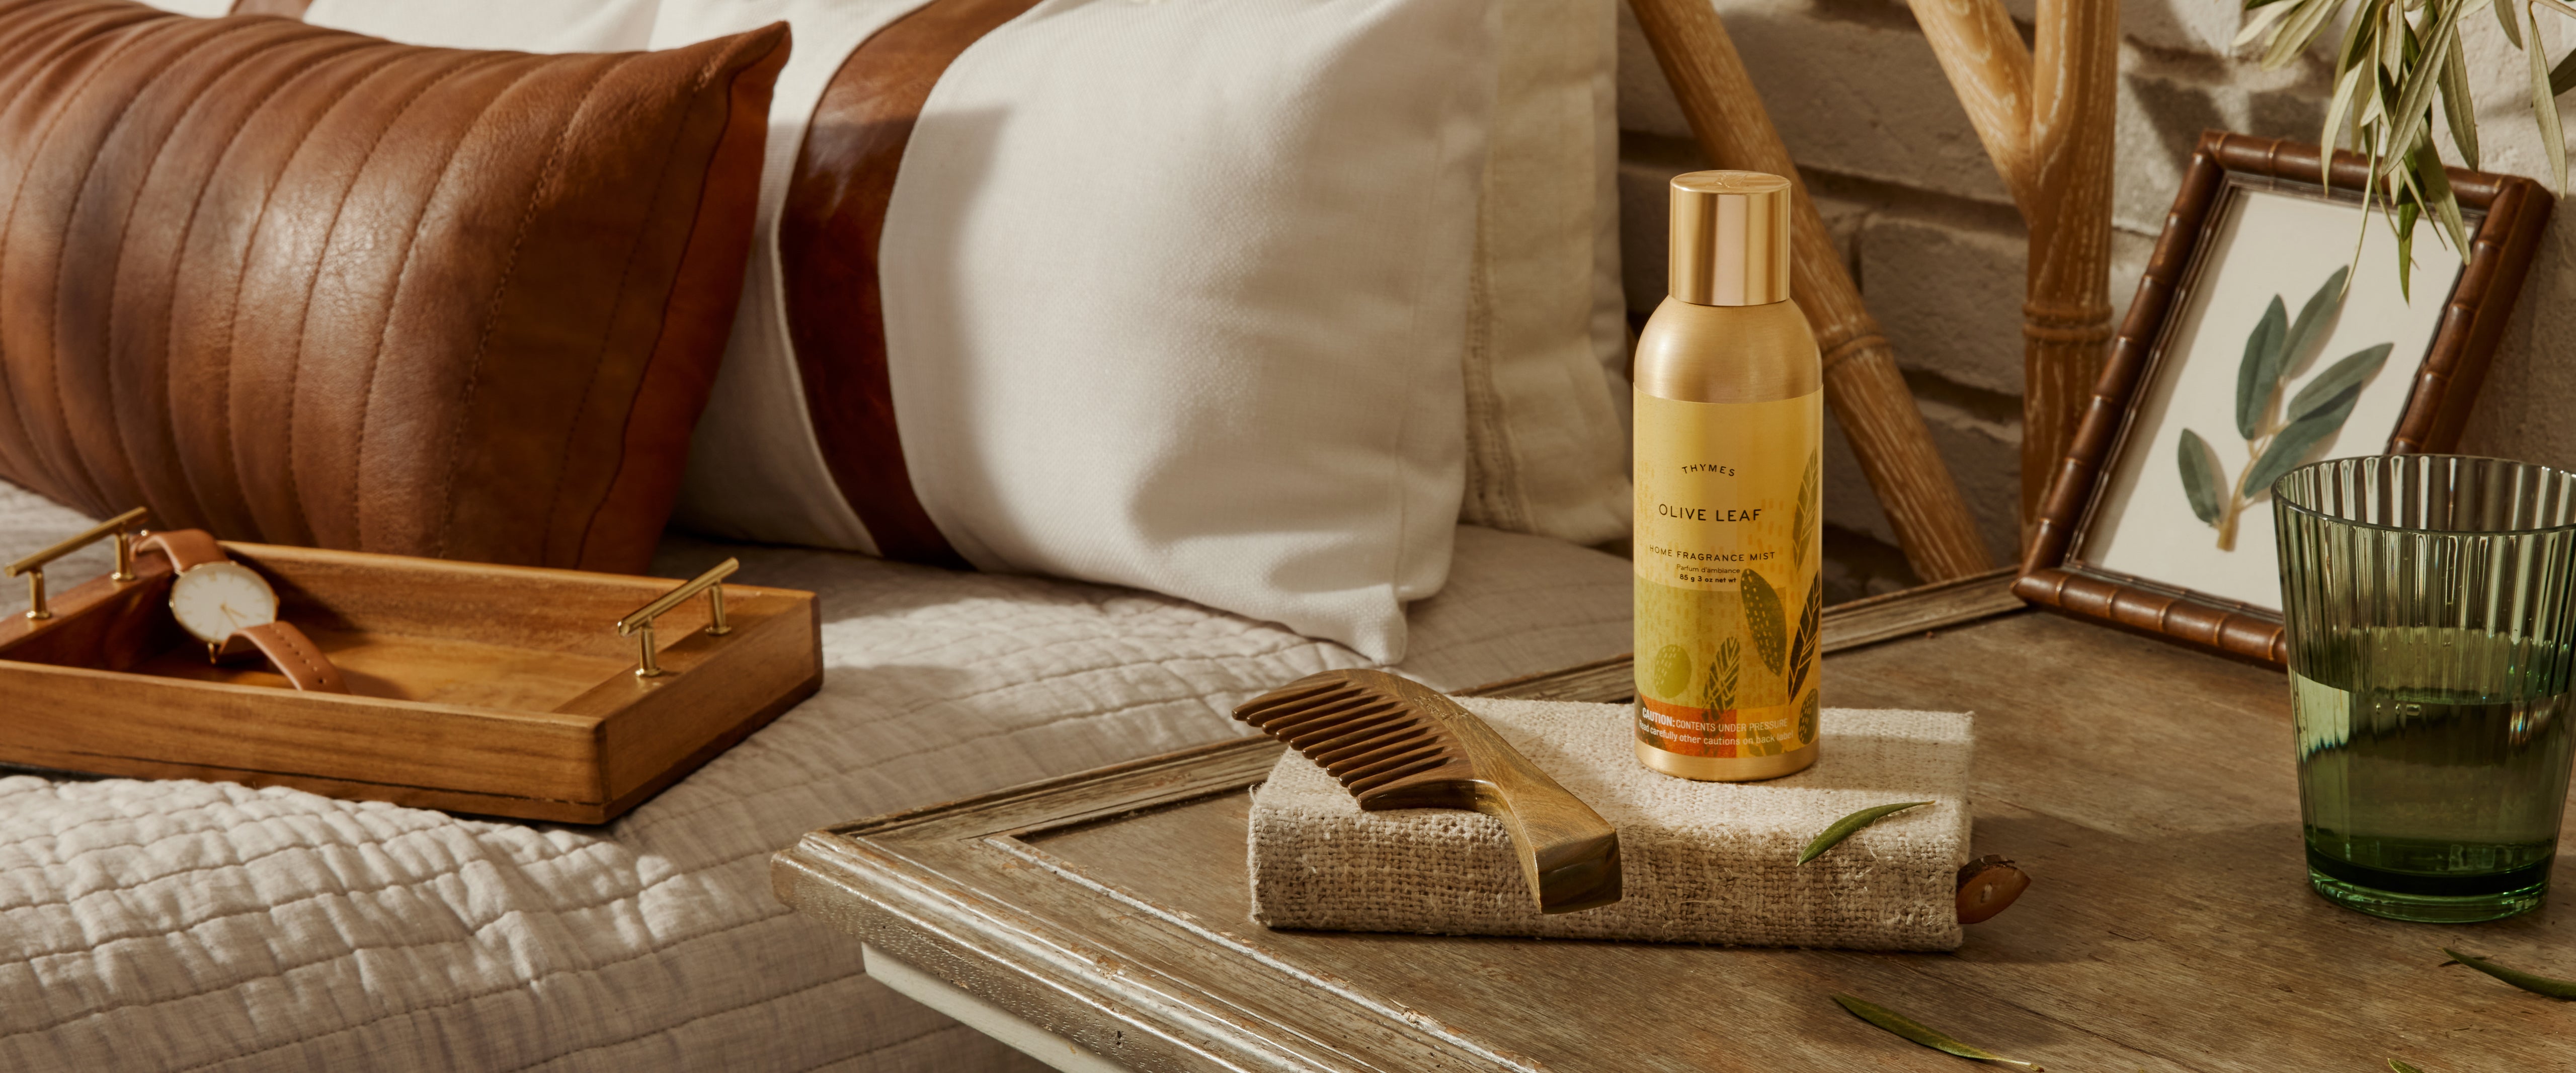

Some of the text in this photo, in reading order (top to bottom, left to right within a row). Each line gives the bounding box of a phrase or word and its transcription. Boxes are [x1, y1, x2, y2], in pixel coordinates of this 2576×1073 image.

[1682, 464, 1735, 476] THYMES
[1659, 504, 1762, 522] OLIVE LEAF
[1650, 545, 1775, 561] HOME FRAGRANCE MIST
[1676, 564, 1699, 572] Parfum
[1642, 707, 1788, 732] CAUTION: CONTENTS UNDER PRESSURE
[1639, 719, 1649, 731] Read
[1650, 727, 1677, 742] carefully
[1679, 734, 1701, 744] other
[1704, 735, 1740, 745] cautions
[1756, 733, 1775, 744] back
[1777, 730, 1793, 741] label
